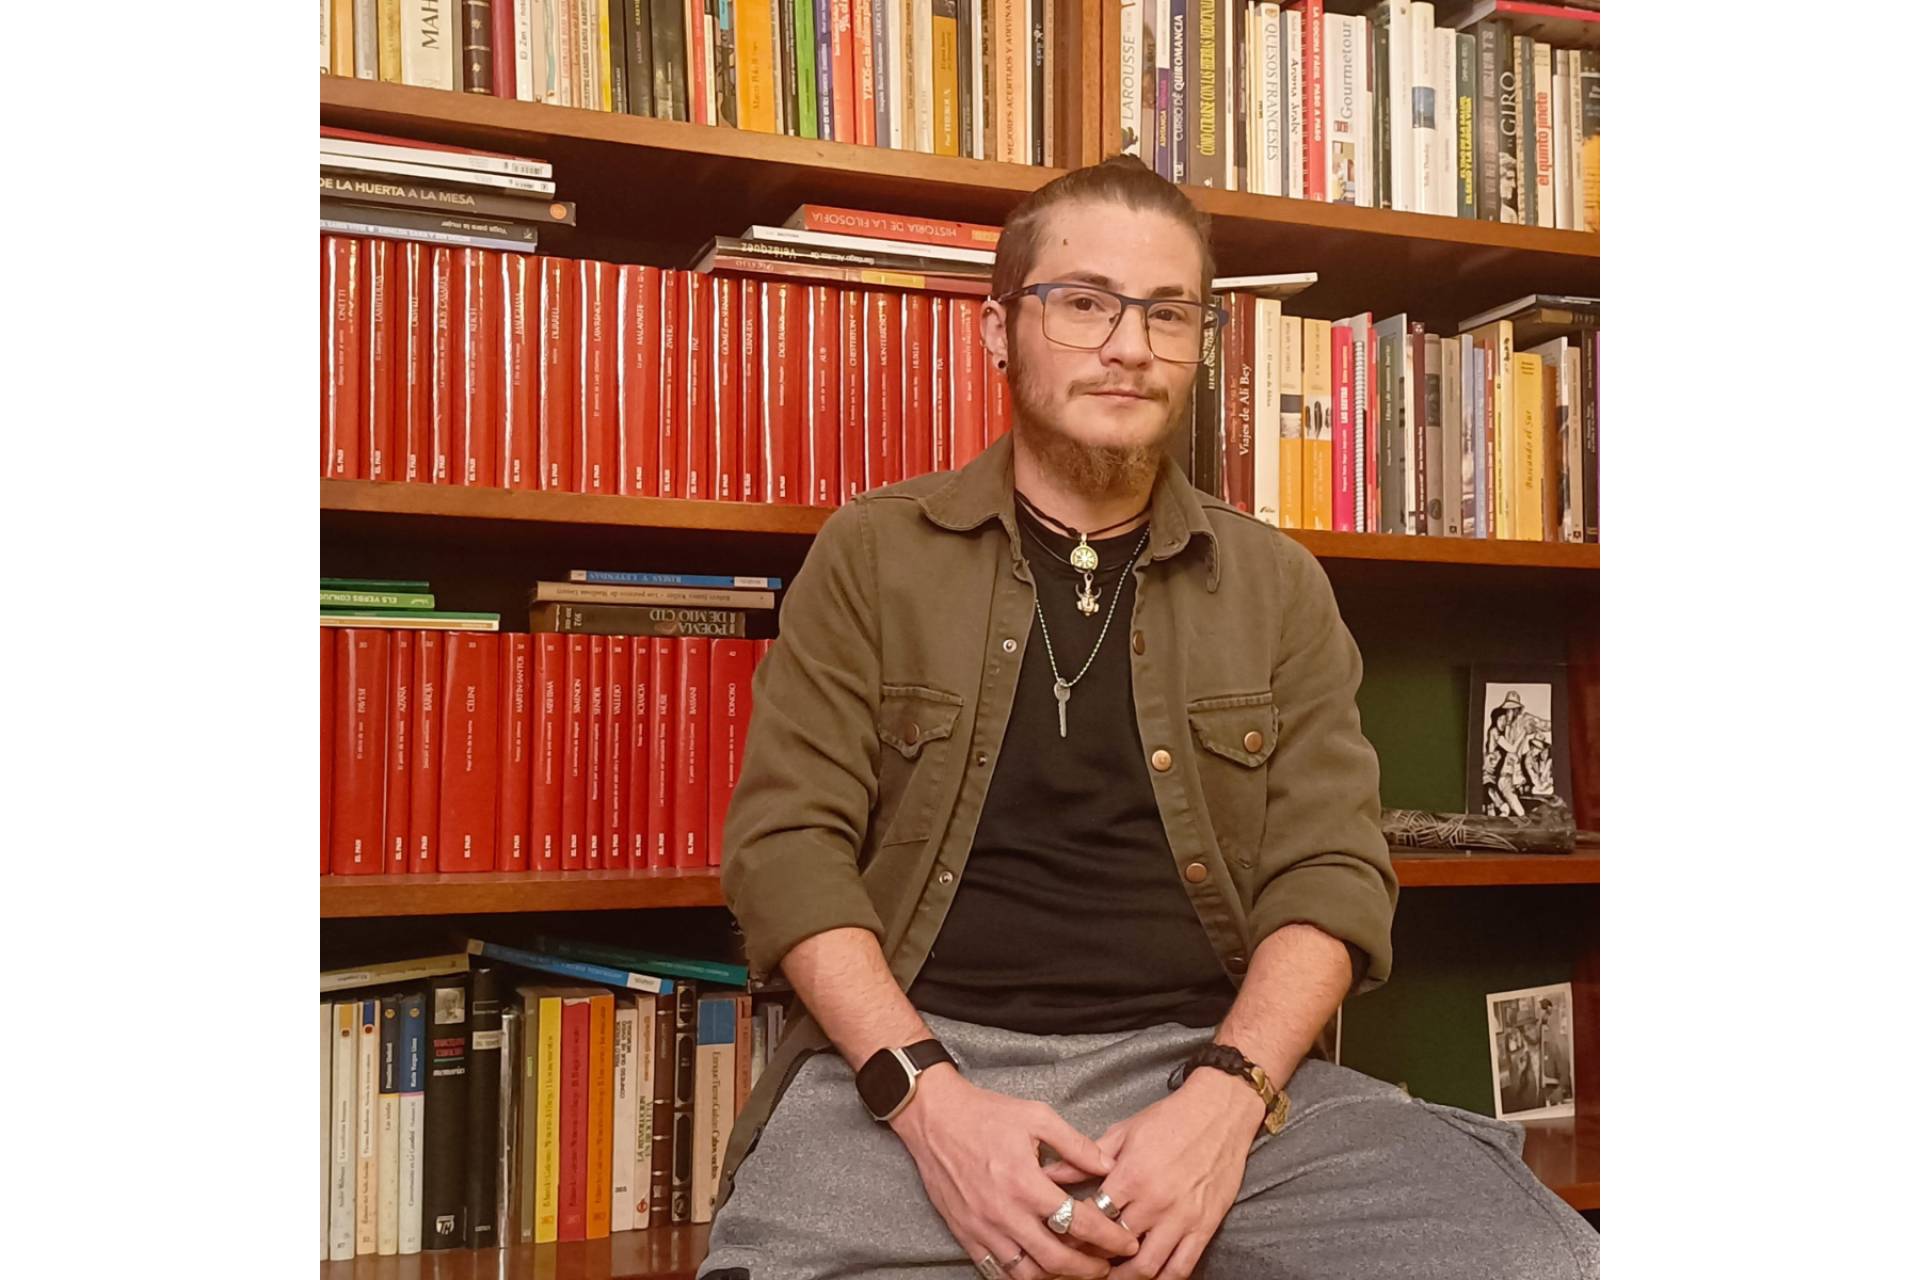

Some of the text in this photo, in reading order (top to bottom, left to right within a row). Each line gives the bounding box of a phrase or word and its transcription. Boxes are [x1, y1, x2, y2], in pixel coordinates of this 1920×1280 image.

[1173, 14, 1184, 91] QUIROMANCIA
[1122, 35, 1135, 120] LAROUSSE
[1340, 21, 1354, 119] Gourmetour
[1265, 23, 1279, 161] QUESOS FRANCESES
[1499, 71, 1516, 136] GIRO
[1174, 107, 1184, 142] CURSO
[1536, 92, 1552, 186] el quinto jinete
[336, 180, 353, 191] LA
[355, 183, 406, 197] HUERTA
[407, 189, 418, 198] A
[419, 189, 437, 201] LA
[439, 191, 476, 205] MESA
[872, 218, 887, 230] LA
[890, 221, 904, 232] DE
[907, 222, 957, 237] HISTORIA
[741, 242, 797, 260] Velázquez
[338, 289, 346, 321] ONETTI
[593, 301, 601, 342] LAWRENCE
[636, 304, 644, 346] MALAPARTE
[745, 319, 753, 355] CERNUDA
[849, 319, 857, 366] CHESTERTON
[1240, 363, 1252, 385] Bey
[1240, 408, 1250, 421] de
[1523, 410, 1533, 427] Sur
[1239, 423, 1252, 456] Viajes
[1524, 442, 1534, 489] Buscando
[352, 595, 379, 603] VERBS
[381, 596, 397, 604] ELS
[649, 608, 727, 622] DE MIO CID
[678, 622, 728, 635] POEMA
[573, 678, 581, 714] SIMENON
[613, 684, 621, 715] VALLEJO
[728, 683, 736, 717] DONOSO
